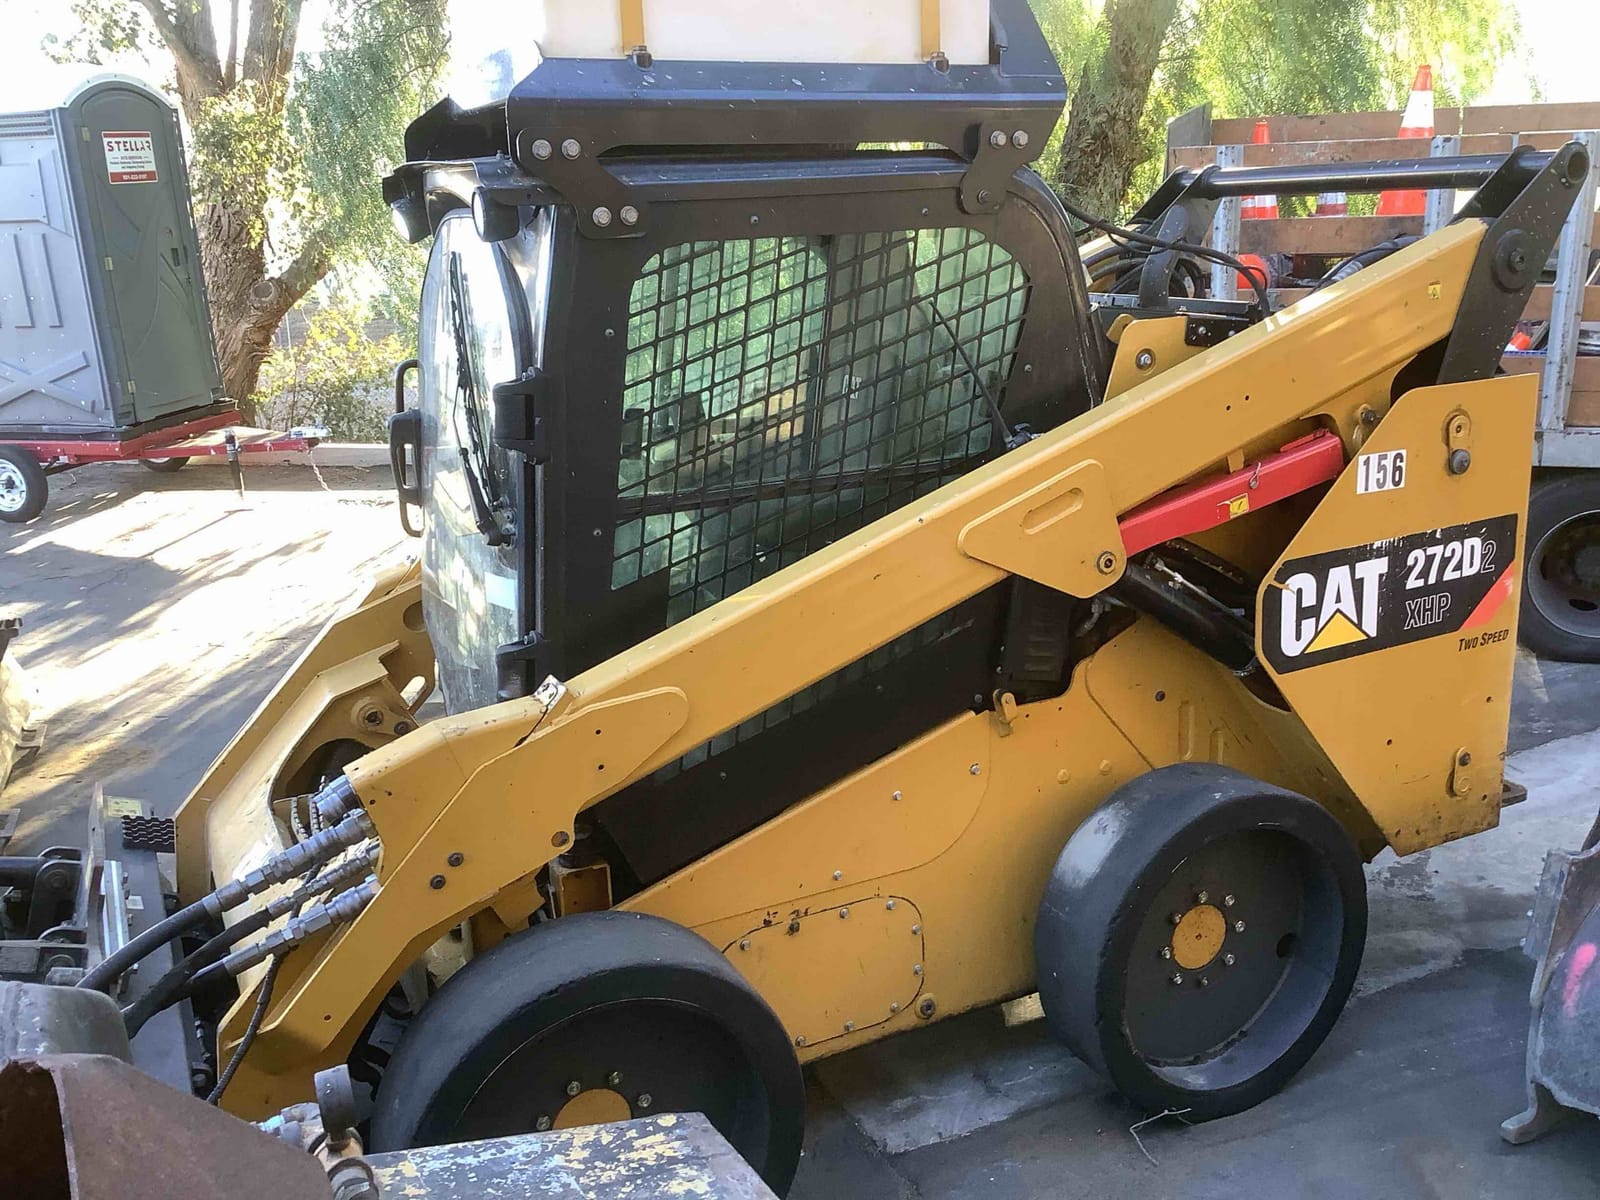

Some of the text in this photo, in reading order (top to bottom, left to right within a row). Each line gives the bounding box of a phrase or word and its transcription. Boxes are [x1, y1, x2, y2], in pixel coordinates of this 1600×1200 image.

[106, 140, 152, 152] STELLAR
[1363, 452, 1405, 491] 156
[1405, 536, 1497, 590] 272D2
[1280, 557, 1389, 657] CAT
[1403, 592, 1451, 630] XHP
